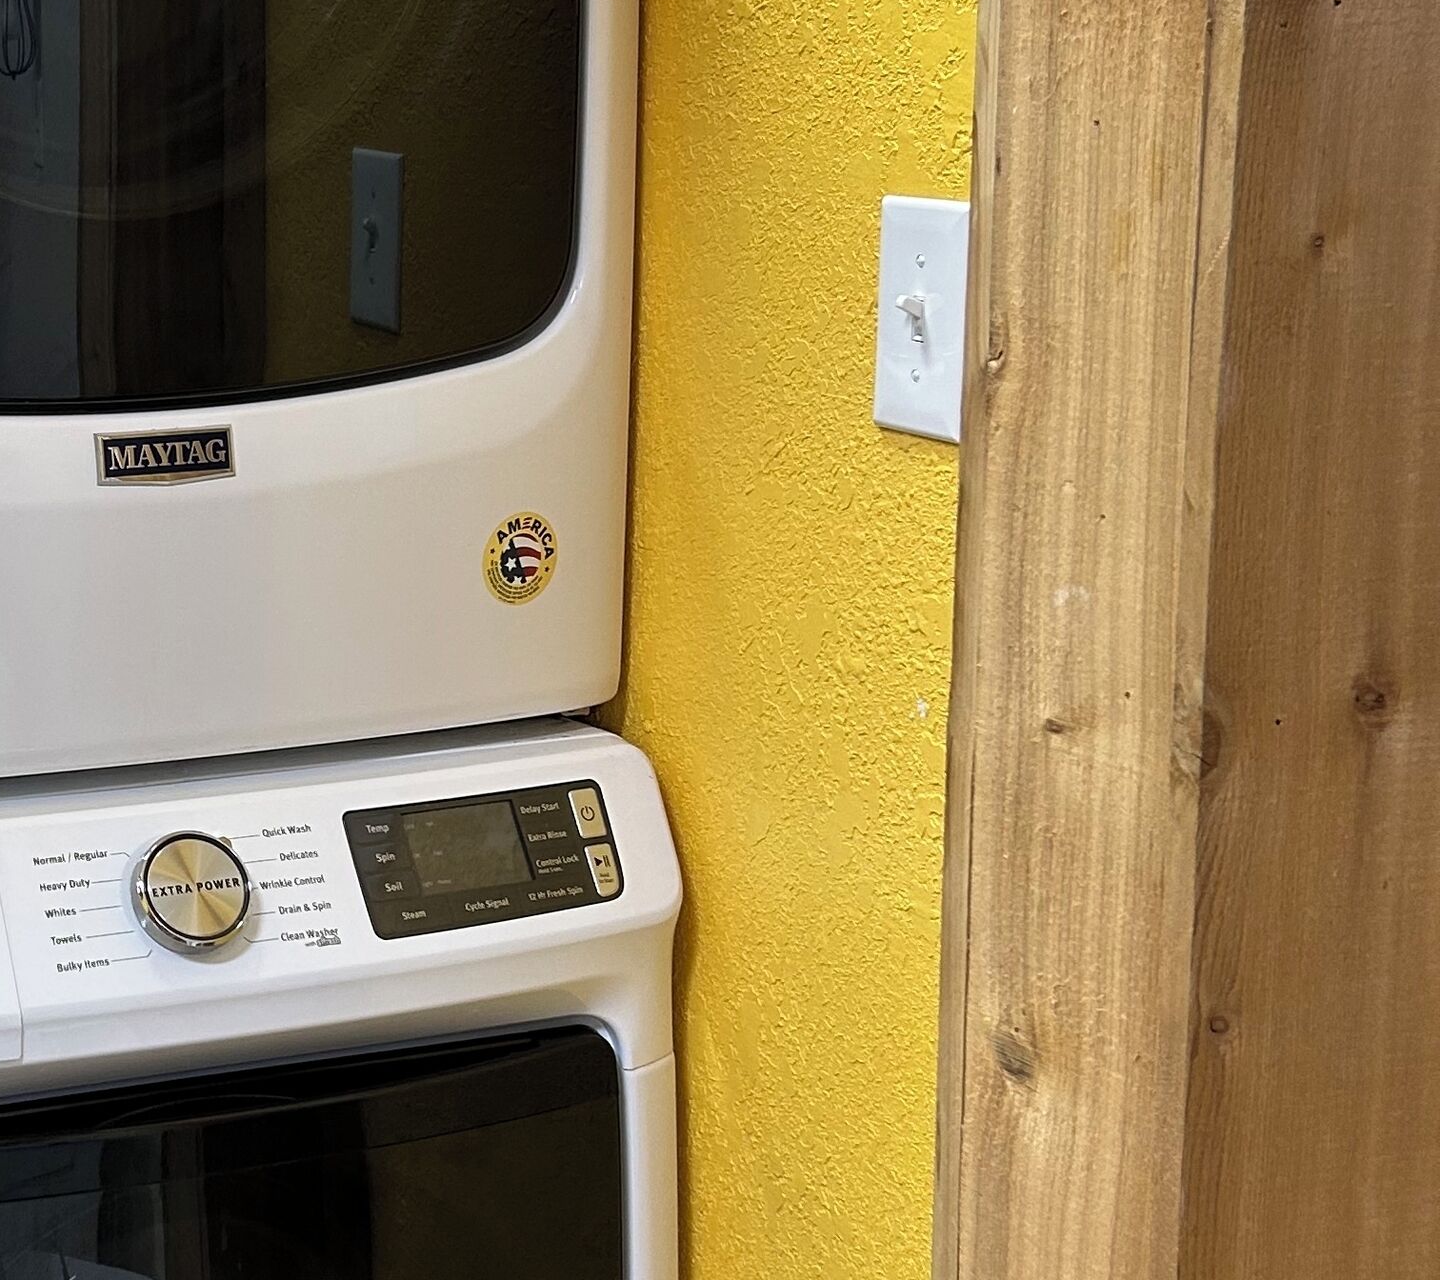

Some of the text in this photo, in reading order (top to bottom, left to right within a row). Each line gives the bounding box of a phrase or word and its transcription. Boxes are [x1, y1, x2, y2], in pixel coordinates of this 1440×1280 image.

[107, 439, 227, 470] MAYTAG
[497, 517, 554, 560] AMERICA
[520, 802, 560, 815] Delay Start
[262, 824, 311, 838] Quick Wash
[365, 824, 390, 834] Temp
[547, 830, 567, 839] Rinse
[33, 854, 65, 866] Normal
[74, 850, 108, 861] Regular
[279, 849, 319, 861] Delicates
[375, 852, 396, 864] Spin
[536, 854, 579, 868] Control Lock
[40, 879, 90, 892] Heavy Duty
[152, 877, 240, 898] EXTRA POWER
[259, 875, 325, 890] Wrinkle Control
[385, 882, 403, 893] Soil
[566, 886, 584, 895] Spin
[278, 905, 301, 915] Drain
[312, 901, 331, 912] Spin
[465, 897, 510, 912] Cycle Signal
[44, 908, 77, 918] Whites
[402, 910, 427, 920] Steam
[50, 933, 82, 945] Towels
[281, 931, 305, 942] Clean
[305, 928, 338, 938] Washer
[56, 959, 110, 973] Bulky Items
